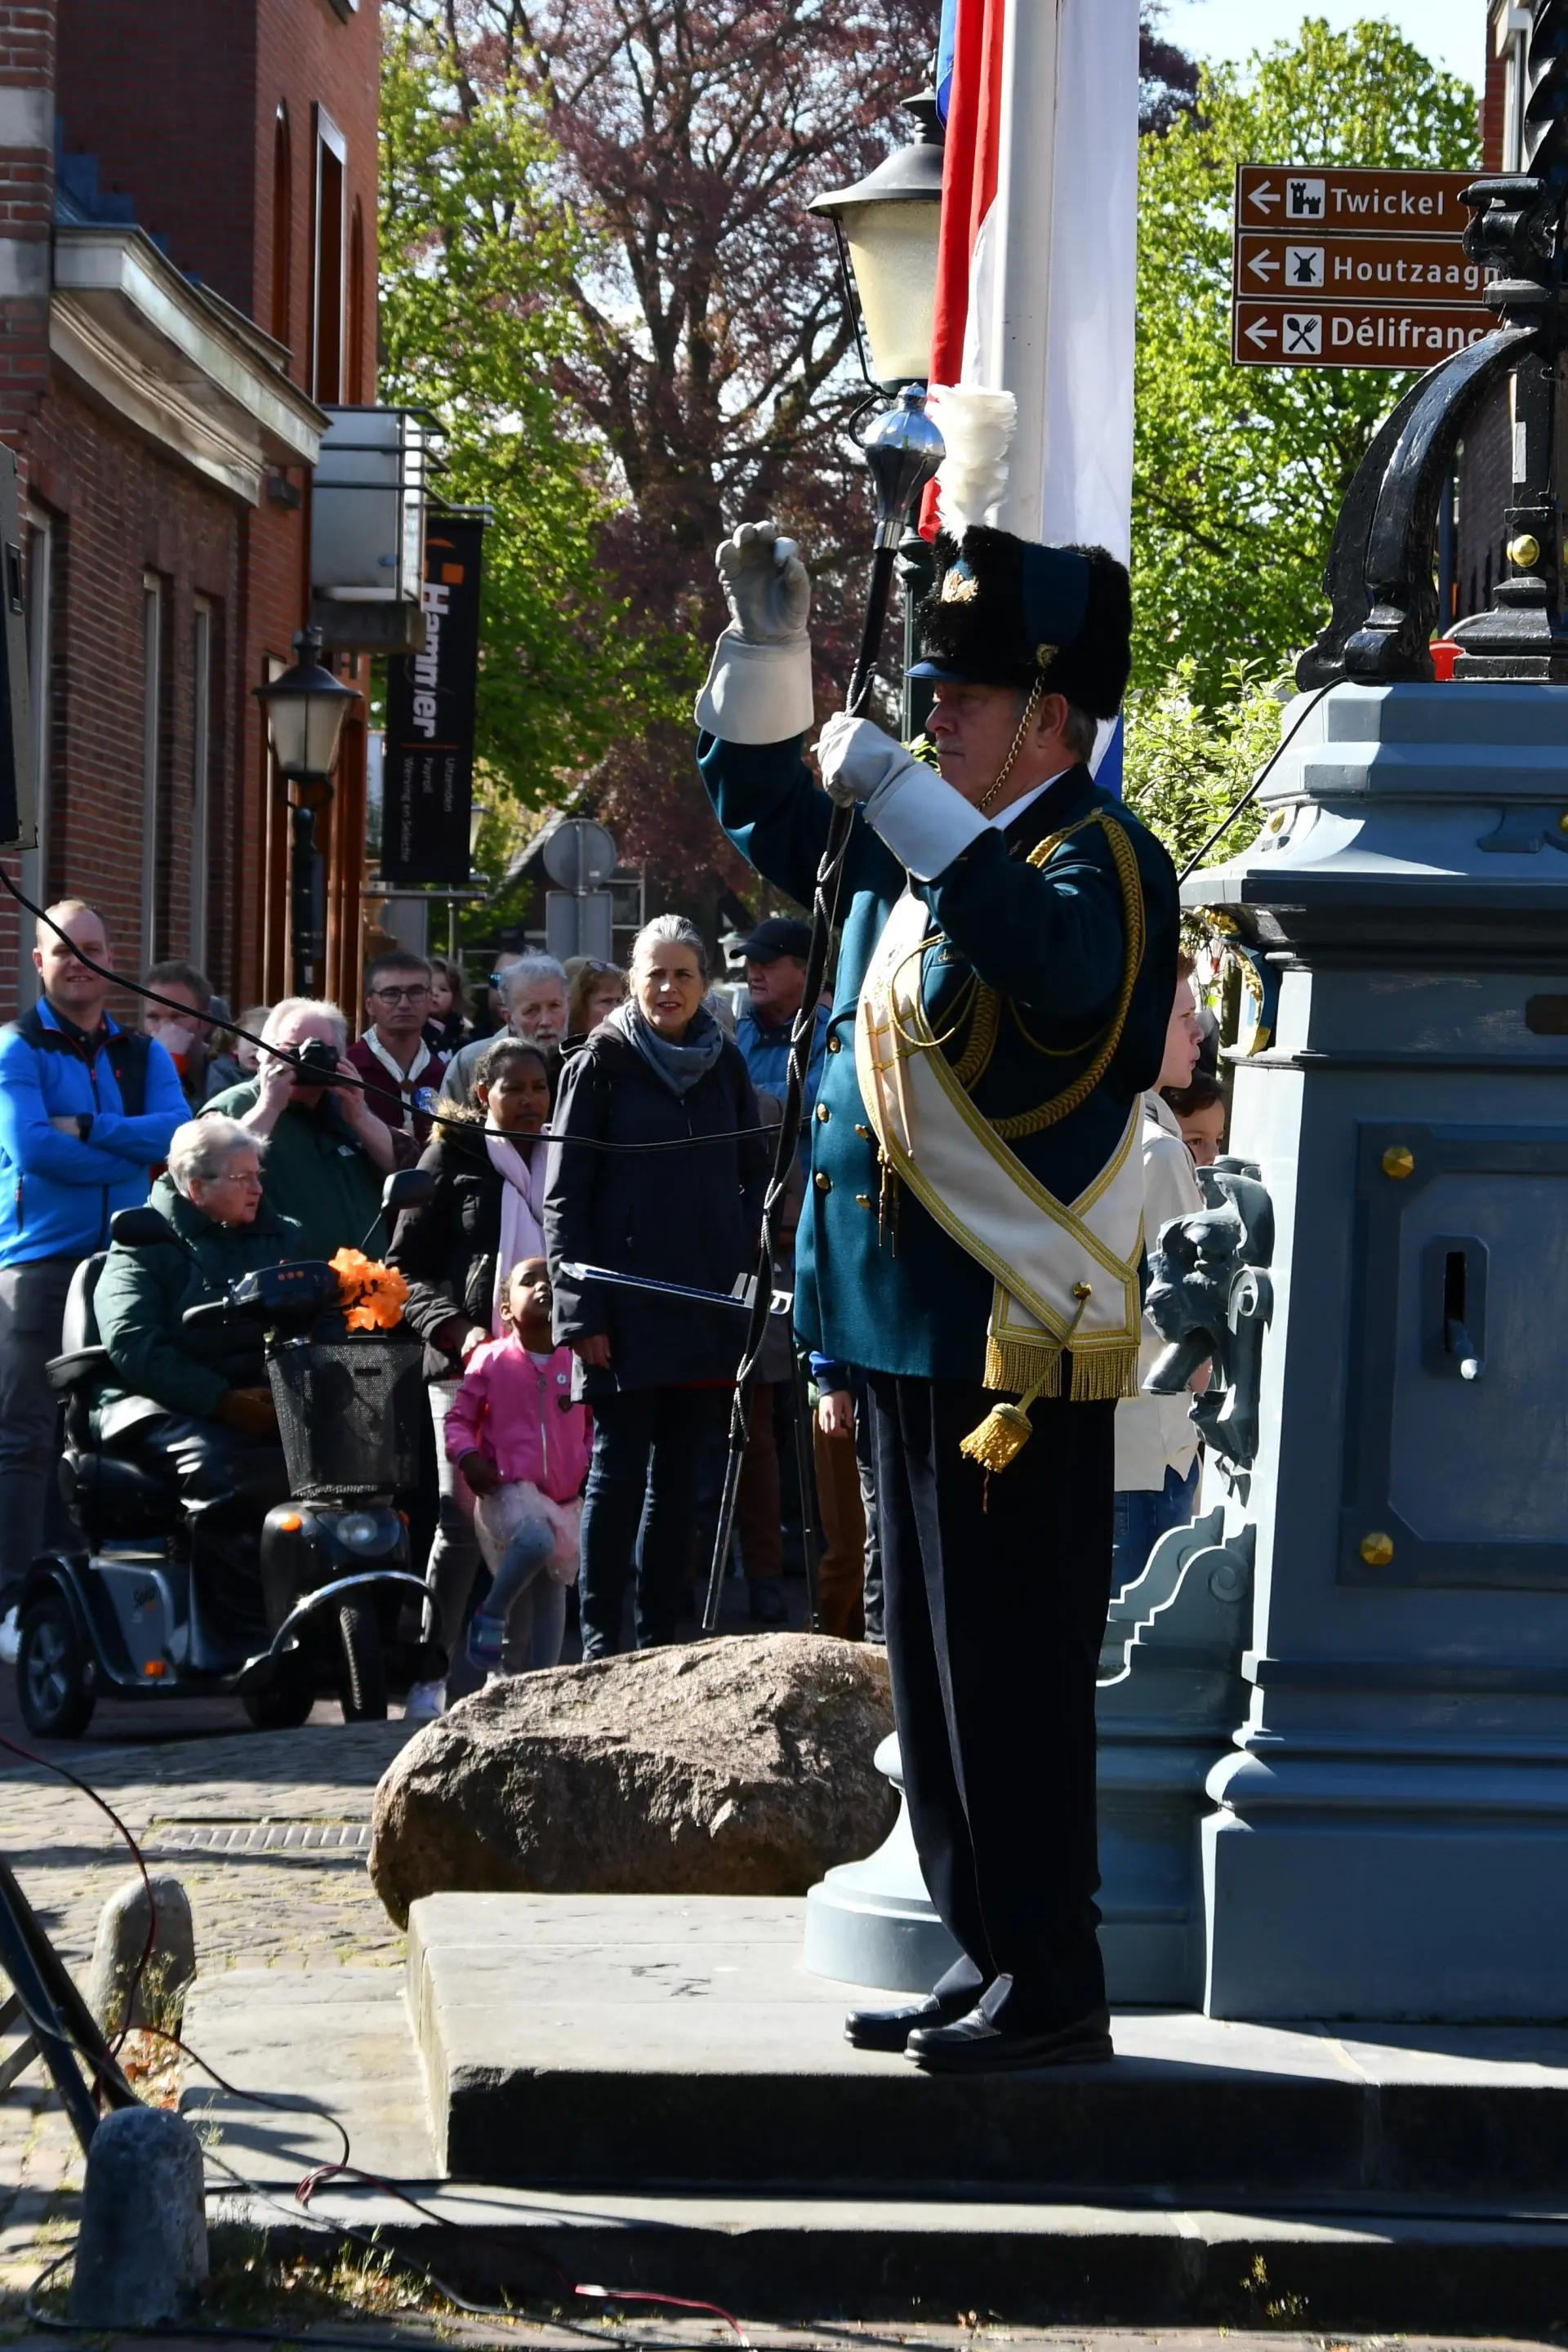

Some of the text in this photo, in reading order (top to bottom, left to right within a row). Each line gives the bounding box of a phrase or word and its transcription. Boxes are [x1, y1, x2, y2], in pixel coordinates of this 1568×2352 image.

[1330, 188, 1444, 216] Twickel
[1331, 316, 1499, 350] Délifranc
[422, 758, 434, 794] Payroll
